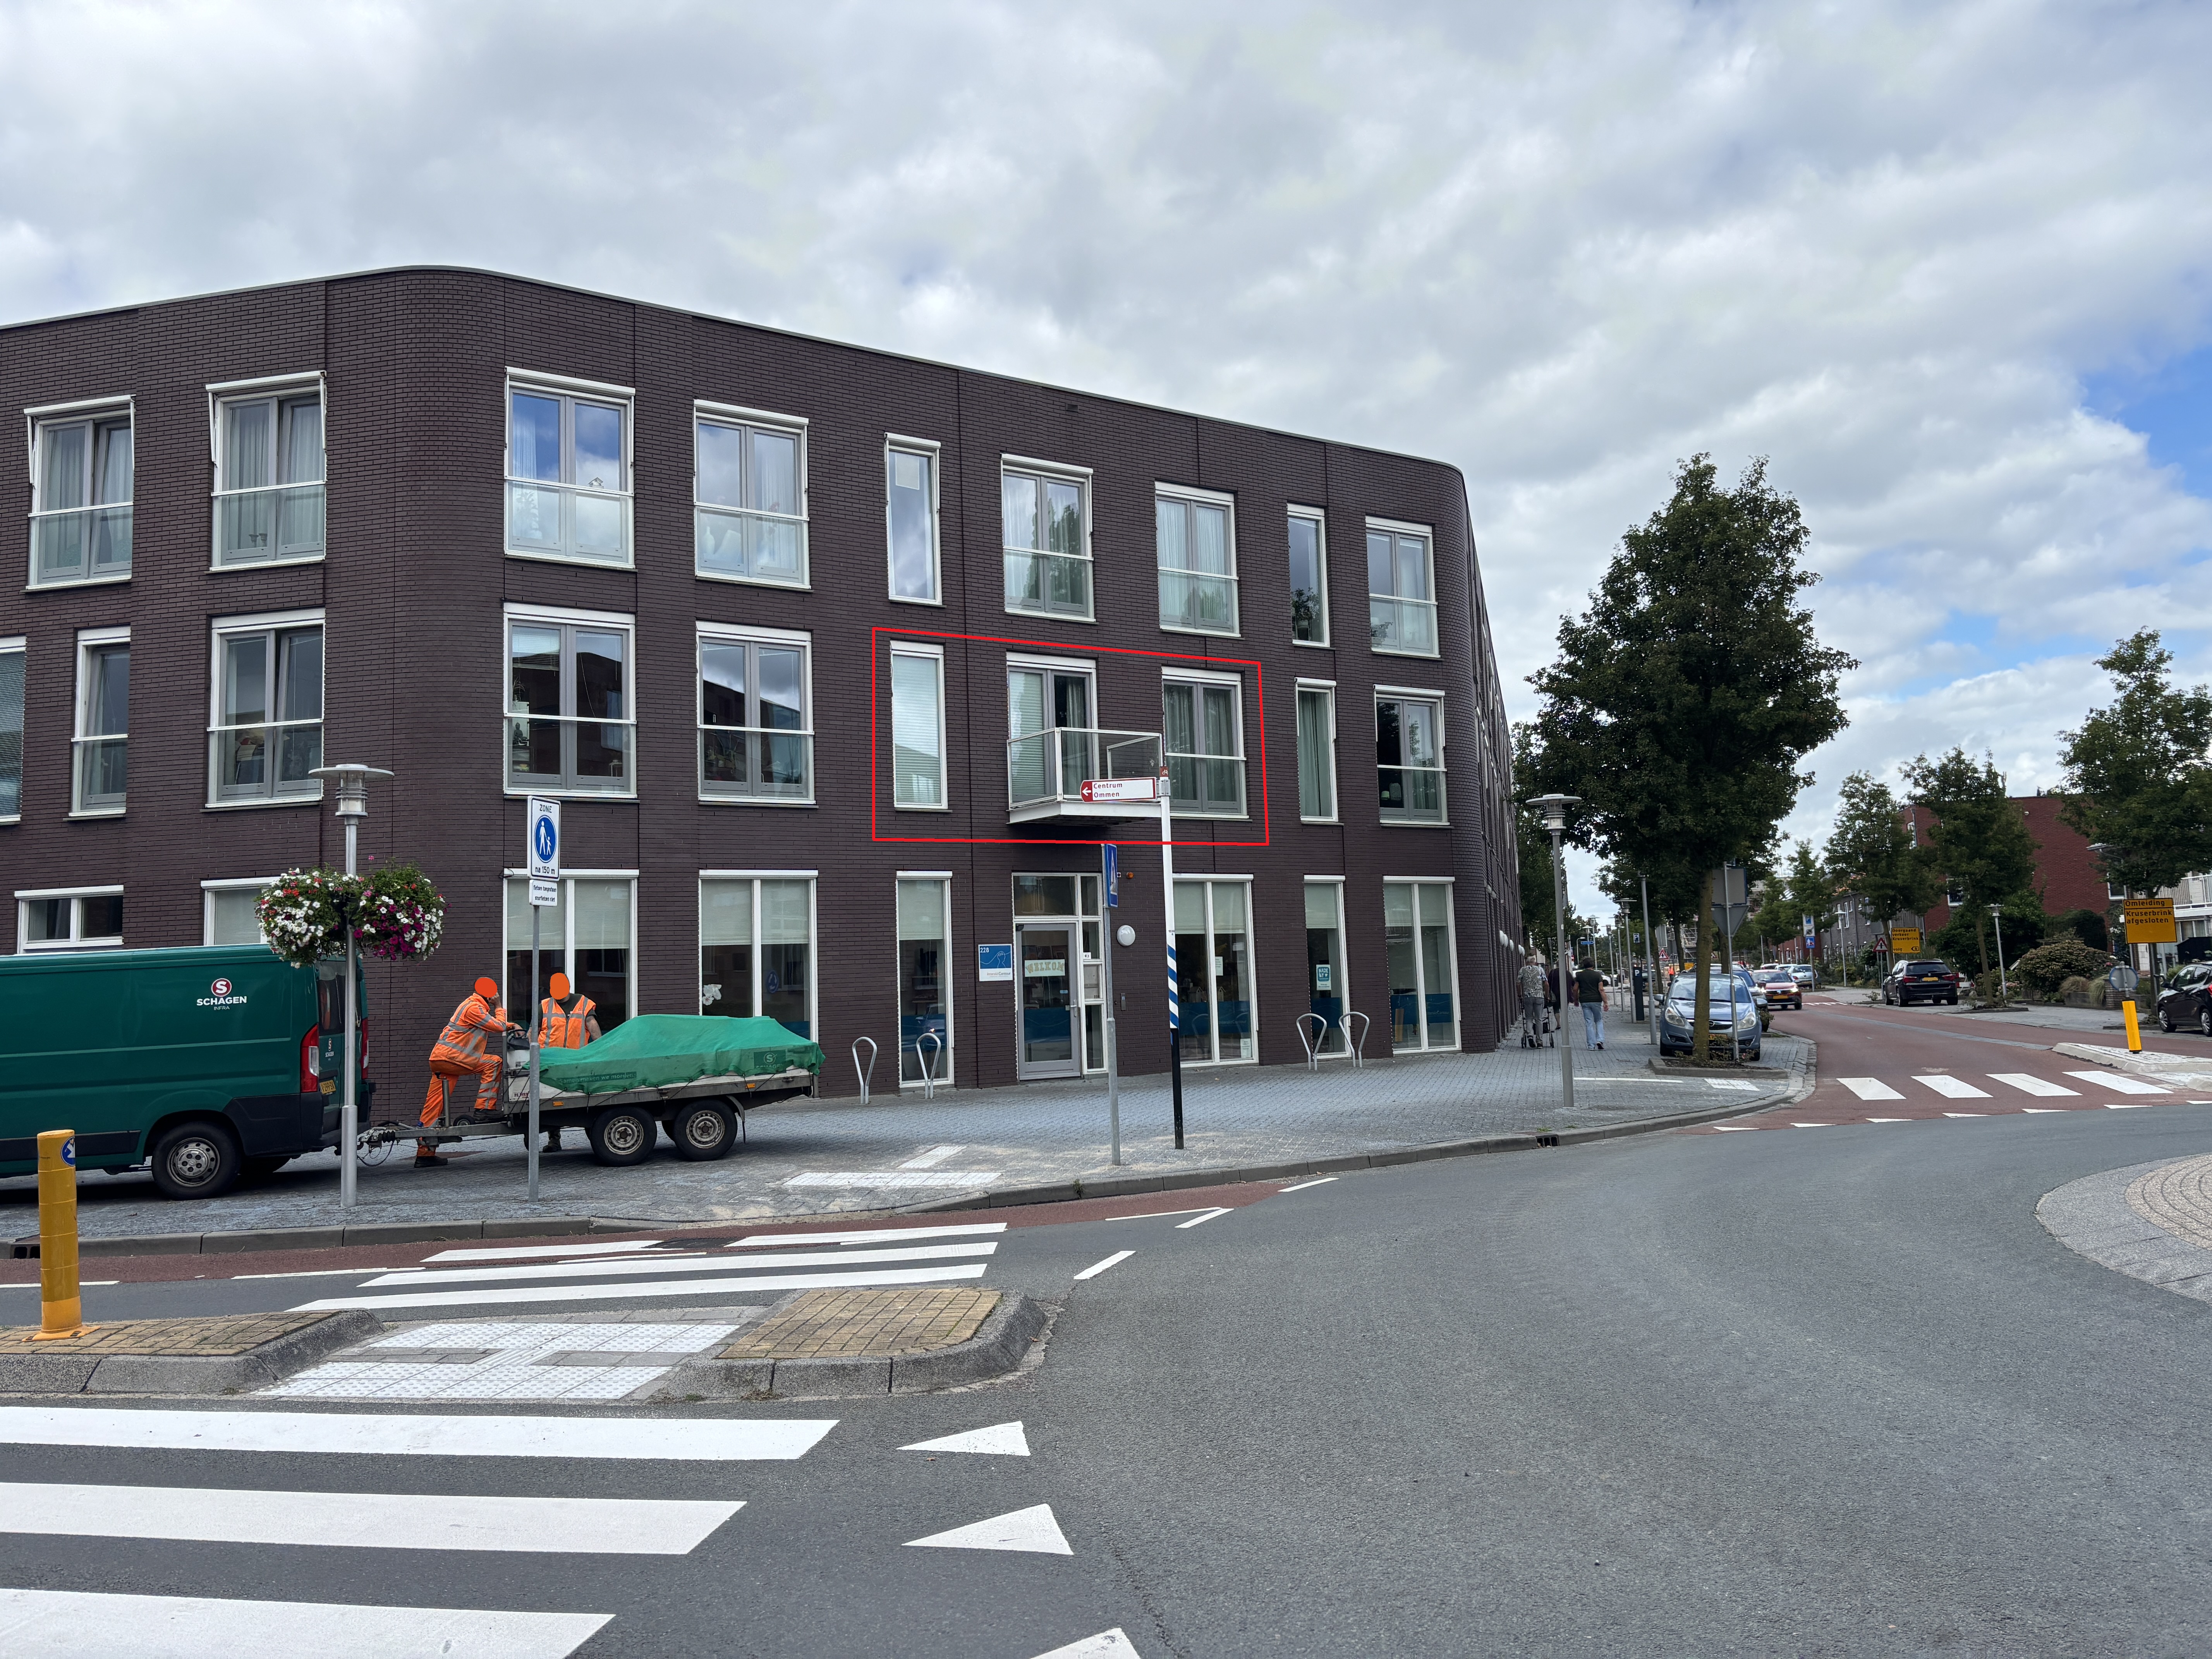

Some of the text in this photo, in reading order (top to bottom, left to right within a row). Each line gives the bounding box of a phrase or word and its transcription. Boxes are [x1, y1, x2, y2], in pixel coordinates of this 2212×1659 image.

[539, 804, 552, 813] ZONE
[1025, 962, 1065, 974] WELKOM
[215, 981, 227, 994] S
[196, 996, 247, 1006] SCHAGEN
[766, 1054, 773, 1063] S
